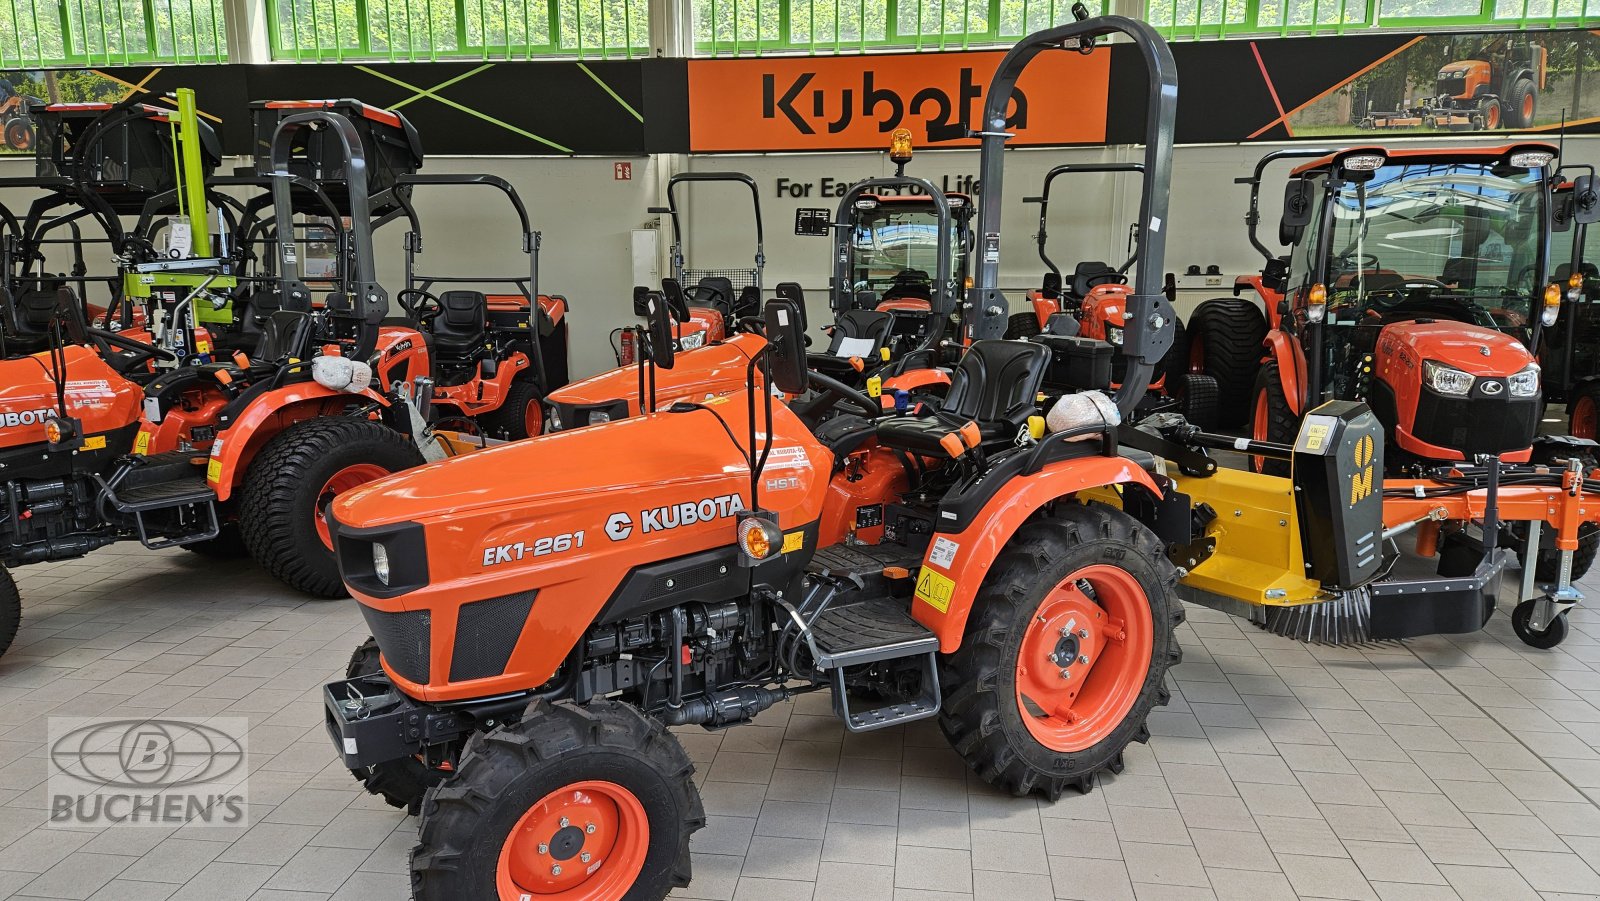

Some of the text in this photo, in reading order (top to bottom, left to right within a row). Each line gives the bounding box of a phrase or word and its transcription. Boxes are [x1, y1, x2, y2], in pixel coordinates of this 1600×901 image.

[763, 68, 1027, 134] Kubota
[776, 177, 812, 198] For
[943, 175, 981, 195] Life
[766, 477, 798, 490] HST
[641, 493, 746, 534] KUBOTA
[482, 530, 585, 566] EK1-261
